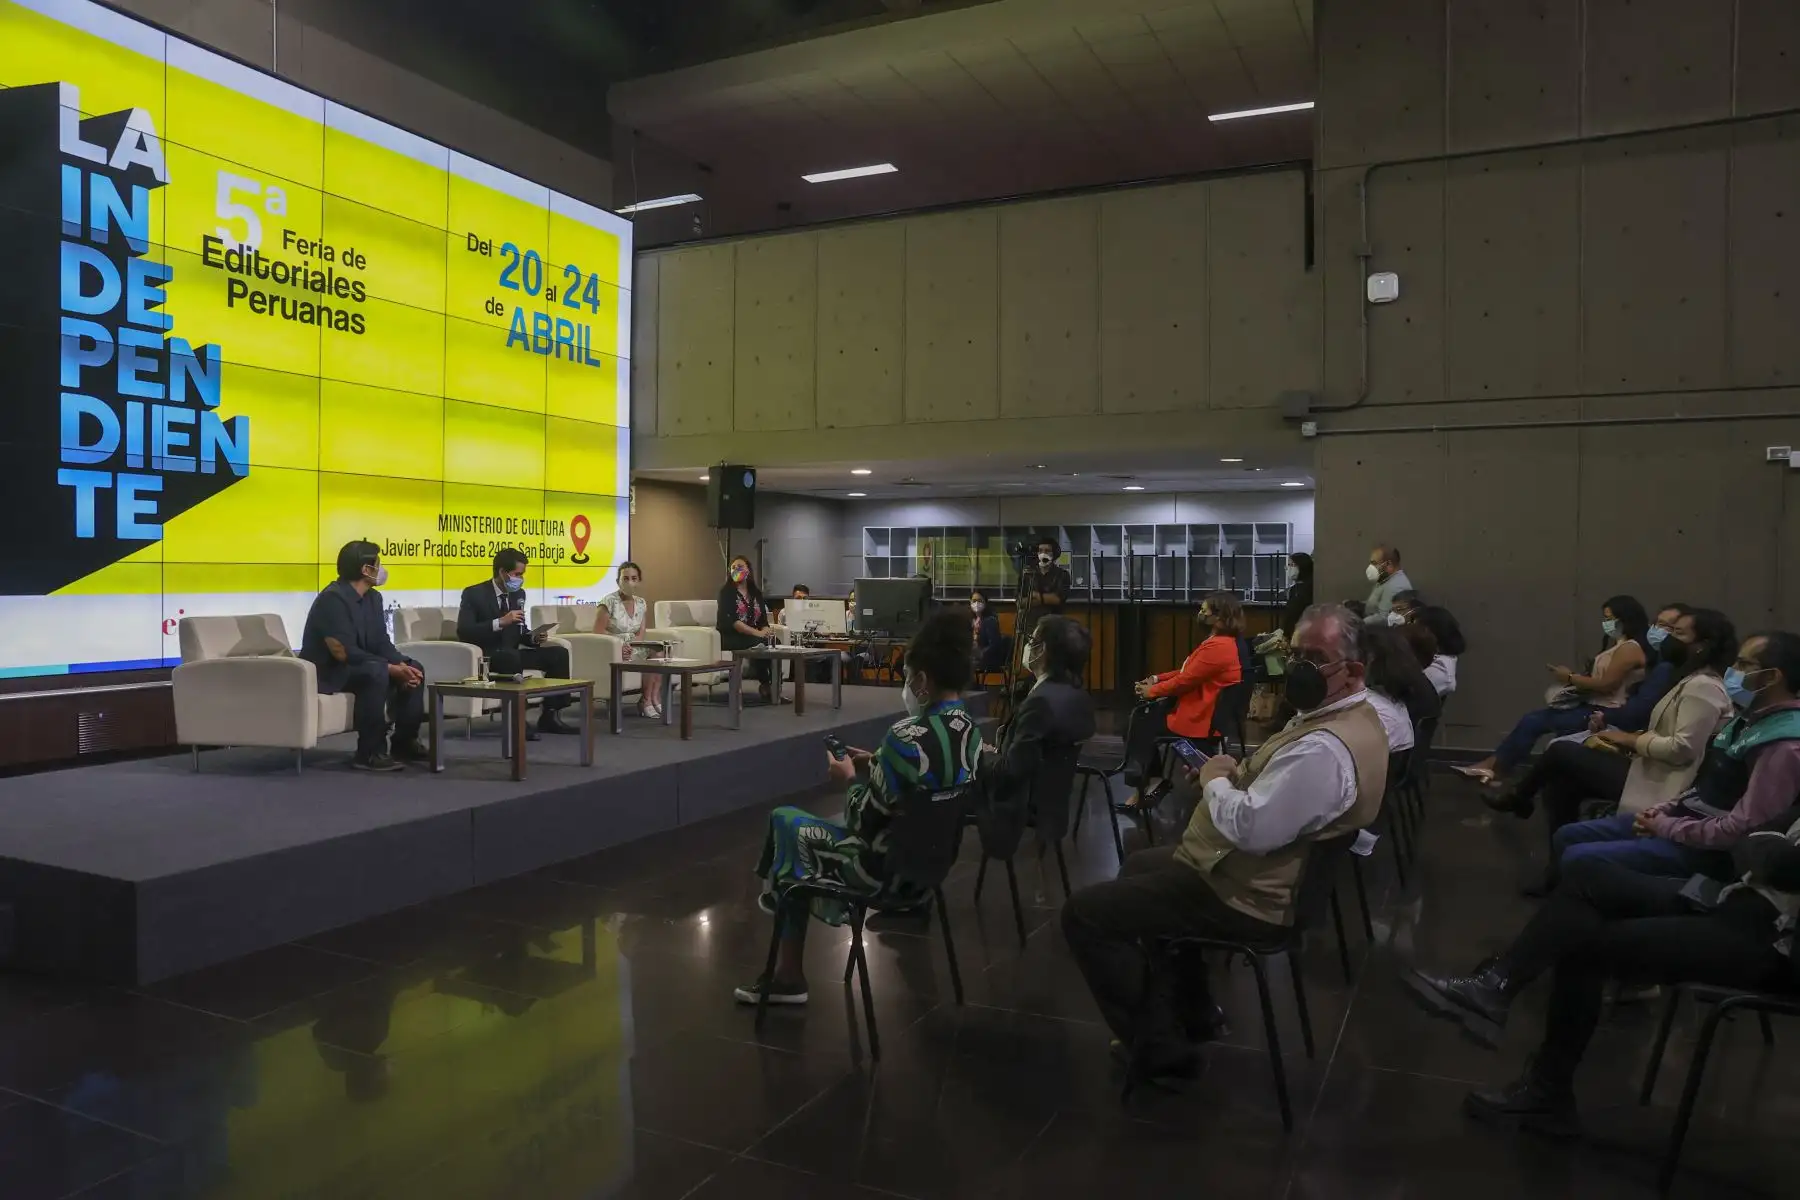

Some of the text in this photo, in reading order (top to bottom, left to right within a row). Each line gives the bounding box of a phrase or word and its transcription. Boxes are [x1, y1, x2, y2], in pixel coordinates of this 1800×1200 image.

[59, 80, 171, 184] LA
[61, 163, 149, 254] IN
[60, 240, 173, 329] DE
[202, 234, 367, 303] Editoriales
[282, 229, 367, 270] Feria de
[467, 232, 601, 315] Del 20 al 24
[227, 277, 366, 335] Peruanas
[485, 296, 601, 368] de ABRIL
[60, 316, 221, 406] PEN
[60, 392, 249, 476] DIEN
[57, 468, 163, 540] TE
[438, 514, 565, 537] MINISTERIO DE CULTURA
[381, 538, 421, 557] Javier
[423, 539, 457, 558] Prado
[460, 541, 486, 558] Este
[539, 544, 565, 564] Borja
